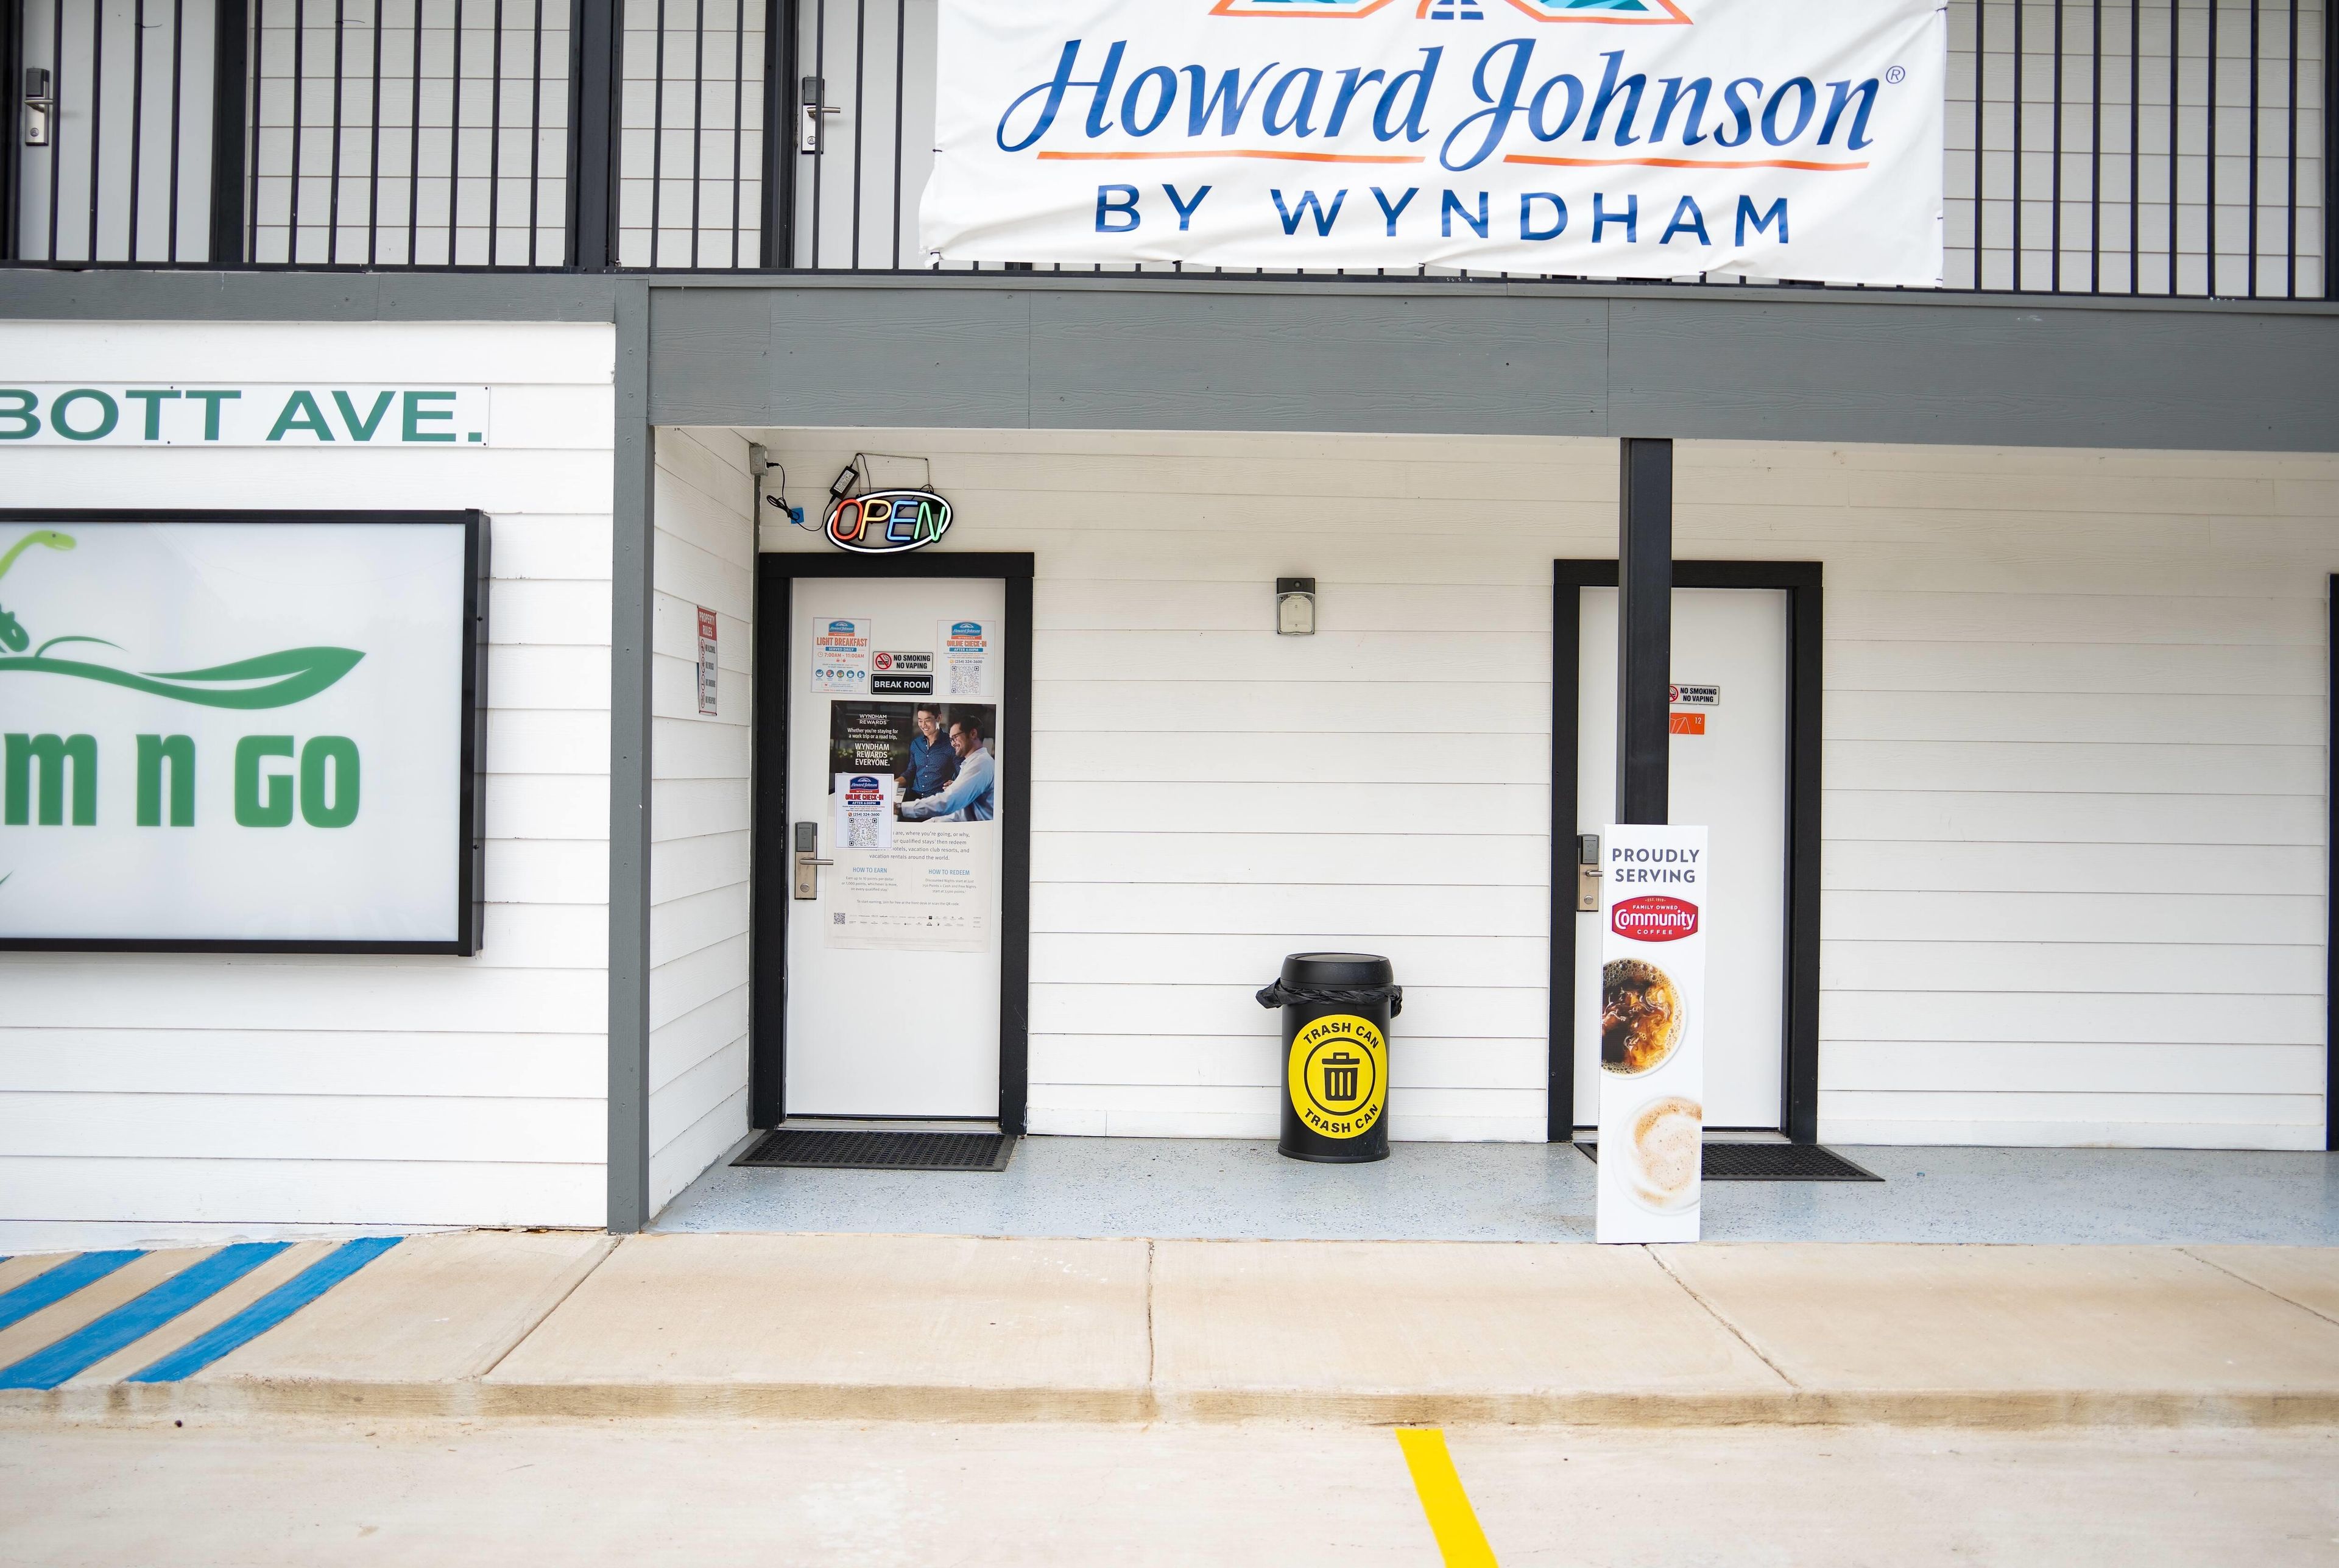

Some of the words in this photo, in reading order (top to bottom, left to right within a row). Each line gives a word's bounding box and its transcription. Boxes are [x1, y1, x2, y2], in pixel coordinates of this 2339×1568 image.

[997, 39, 1444, 152] Howard
[1095, 183, 1212, 232] BY
[1270, 187, 1788, 247] WYNDHAM
[0, 389, 242, 440] BOTT
[266, 390, 482, 442] AVE.
[832, 498, 945, 542] OPEN
[817, 637, 833, 646] LIGHT
[834, 638, 867, 646] BREAKFAST
[136, 733, 196, 827] n
[234, 735, 361, 828] GO
[1612, 848, 1699, 863] PROUDLY
[1615, 869, 1695, 883] SERVING
[1615, 909, 1695, 930] Community
[1303, 1022, 1351, 1045] TRASH
[1356, 1025, 1379, 1049] CAN
[1305, 1108, 1350, 1134] TRASH
[1355, 1103, 1378, 1129] CAN
